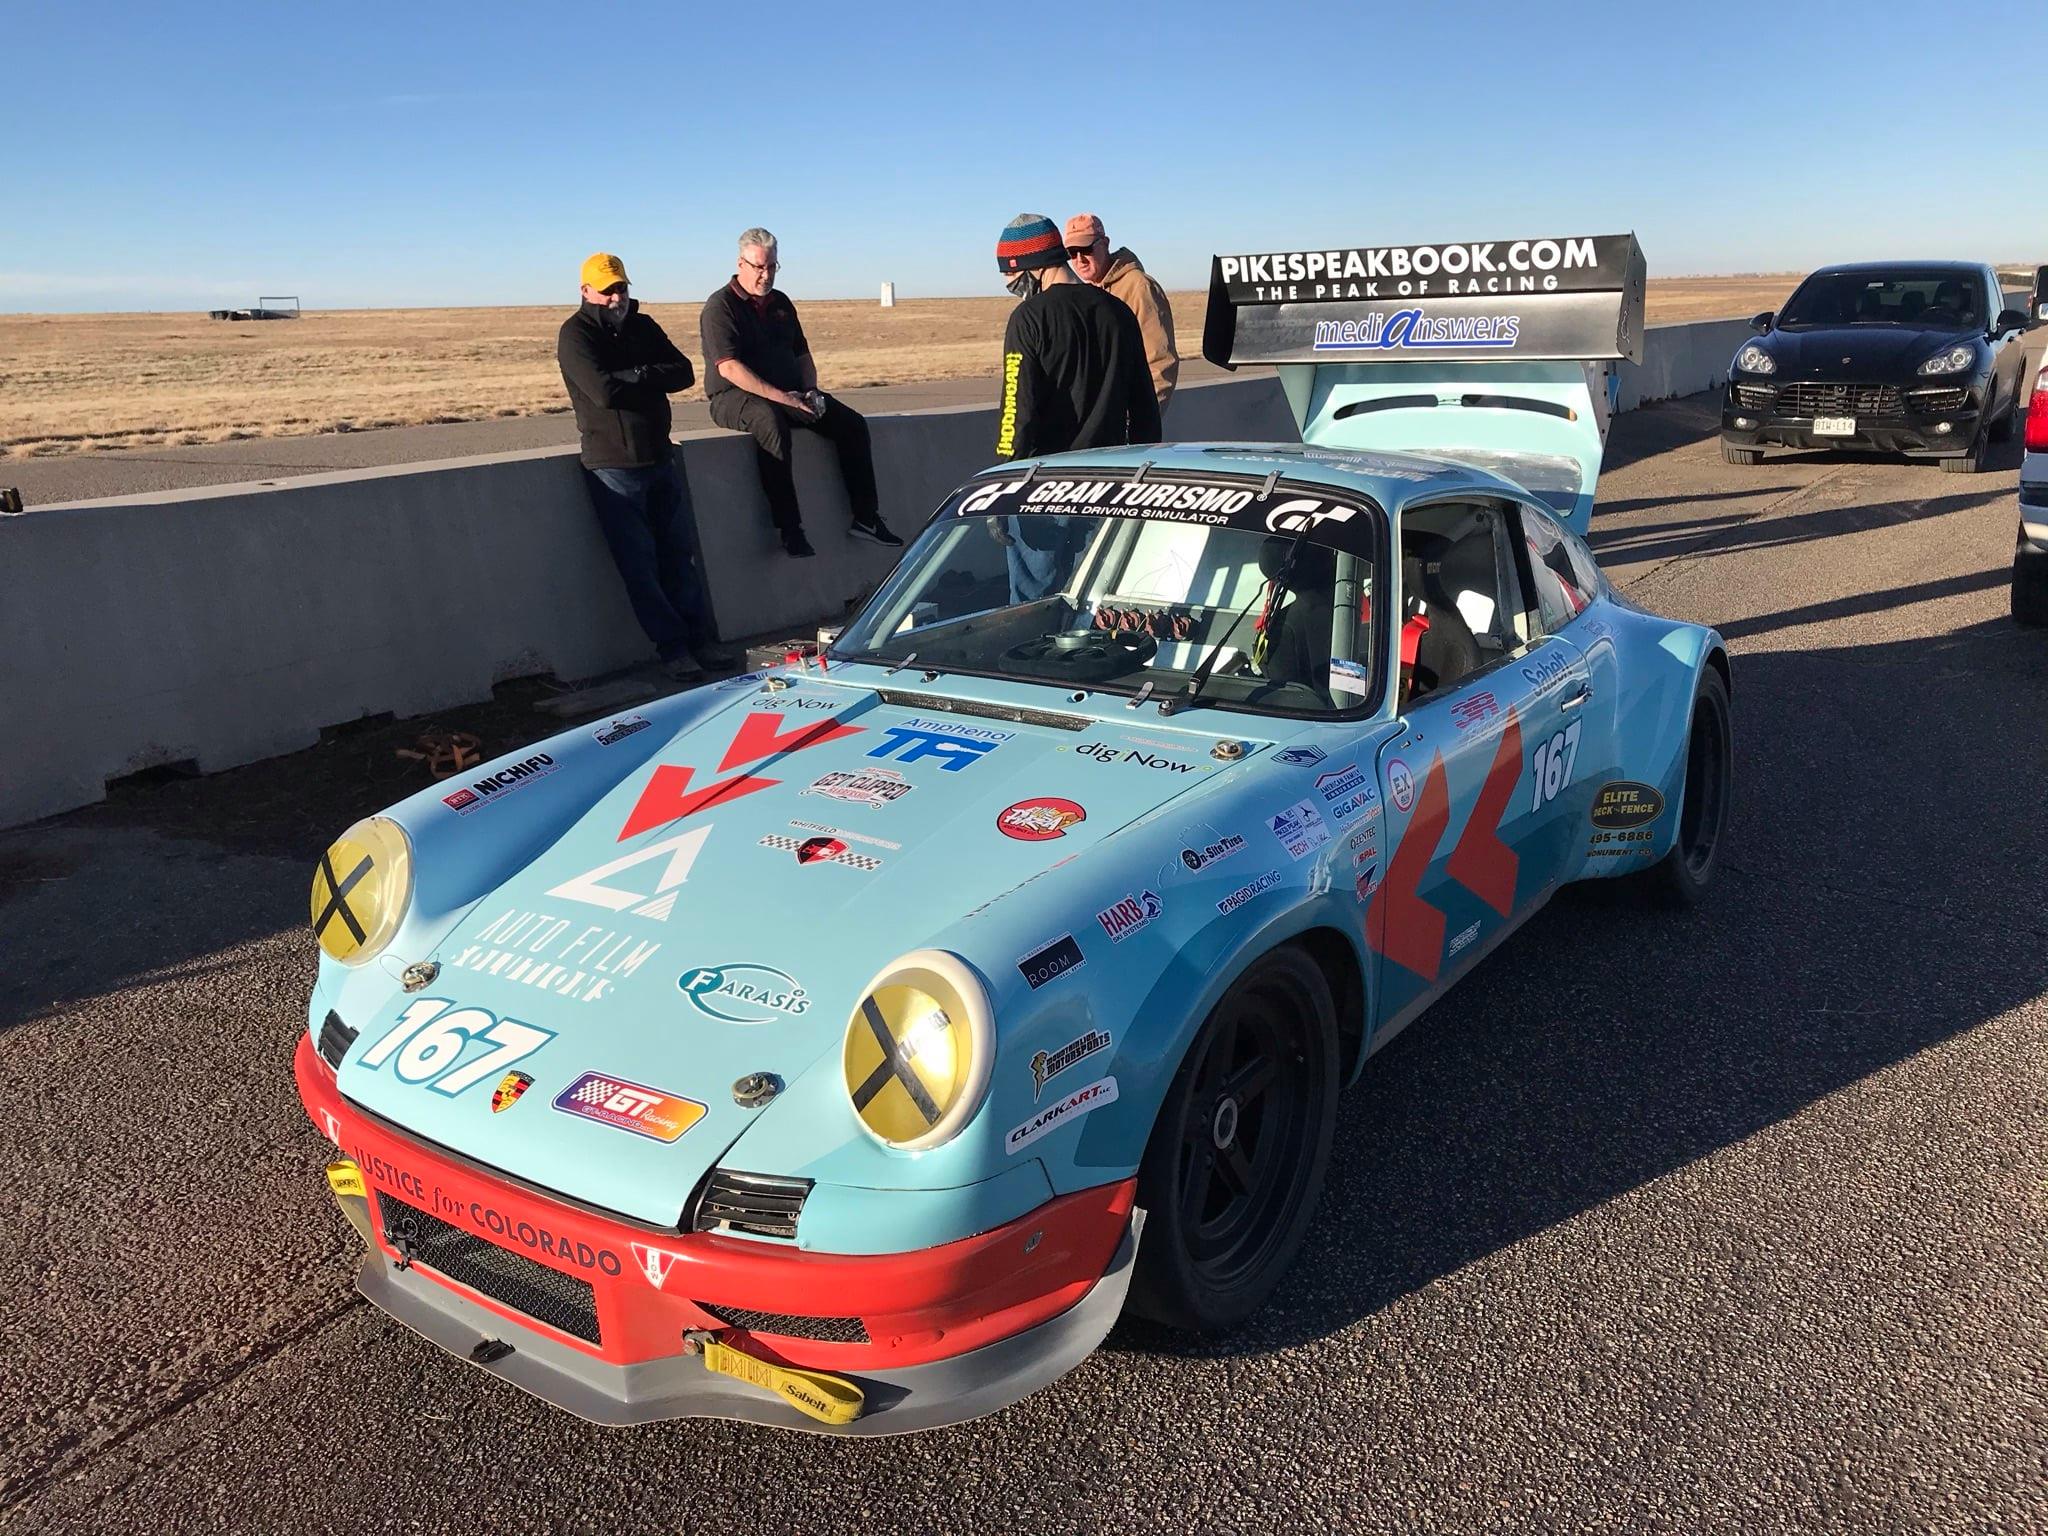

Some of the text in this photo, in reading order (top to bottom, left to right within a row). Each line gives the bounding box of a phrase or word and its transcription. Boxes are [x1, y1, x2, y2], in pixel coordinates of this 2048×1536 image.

[1221, 238, 1598, 284] PIKESPEAKBOOK.COM
[1256, 275, 1559, 301] THE PEAK OF RACING
[1026, 480, 1106, 505] GRAN
[1018, 504, 1229, 525] THE REAL DRIVING SIMULATOR
[898, 716, 1018, 744] Amphenol
[473, 753, 555, 797] NICHIFU
[1531, 716, 1583, 813] 167
[1332, 787, 1376, 819] GIGAVAC
[1602, 789, 1639, 804] ELITE
[1619, 803, 1655, 814] FENCE
[790, 820, 837, 834] WHITFIELD
[1099, 898, 1145, 937] HARB
[473, 908, 662, 978] AUTO FILM
[1028, 954, 1071, 987] ROOM
[355, 996, 560, 1099] 167
[1047, 1031, 1111, 1075] MOTORSPORTS
[603, 1089, 680, 1132] GT Racing
[1010, 1084, 1102, 1143] CLARKART
[430, 1185, 465, 1217] for
[469, 1202, 622, 1276] COLORADO
[784, 1383, 829, 1413] Sabelt
